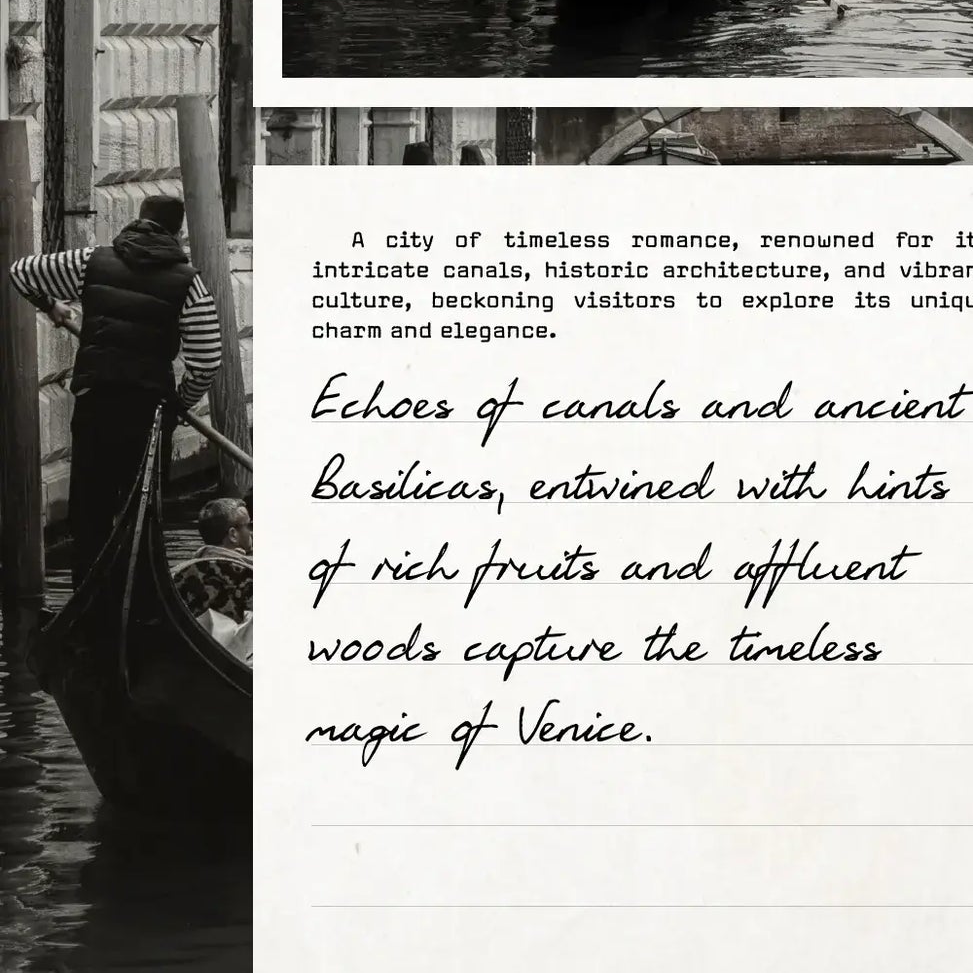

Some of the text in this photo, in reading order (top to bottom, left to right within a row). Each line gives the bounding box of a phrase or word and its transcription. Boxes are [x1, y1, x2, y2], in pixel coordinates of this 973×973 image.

[352, 232, 364, 247] A
[387, 231, 433, 251] city
[456, 232, 481, 247] of
[504, 231, 609, 248] timeless
[632, 235, 738, 251] romance,
[761, 232, 873, 247] renowned
[897, 232, 933, 247] for
[313, 261, 428, 278] intricate
[444, 262, 530, 281] canals,
[546, 261, 648, 278] historic
[664, 261, 829, 281] architecture,
[845, 262, 884, 278] and
[313, 292, 411, 311] culture,
[433, 292, 553, 312] beckoning
[575, 291, 674, 308] visitors
[697, 292, 721, 308] to
[743, 292, 833, 312] explore
[855, 292, 890, 308] its
[313, 322, 555, 342] charm and elegance.
[311, 372, 454, 418] Echoes
[477, 377, 524, 447] of
[543, 380, 680, 418] canals
[702, 381, 793, 418] and
[311, 453, 950, 515] Basilicas, entwined with hints
[309, 539, 922, 609] of rich fruits and affluent
[308, 622, 882, 681] woods capture the timeless
[305, 699, 651, 770] magic of Venice.
